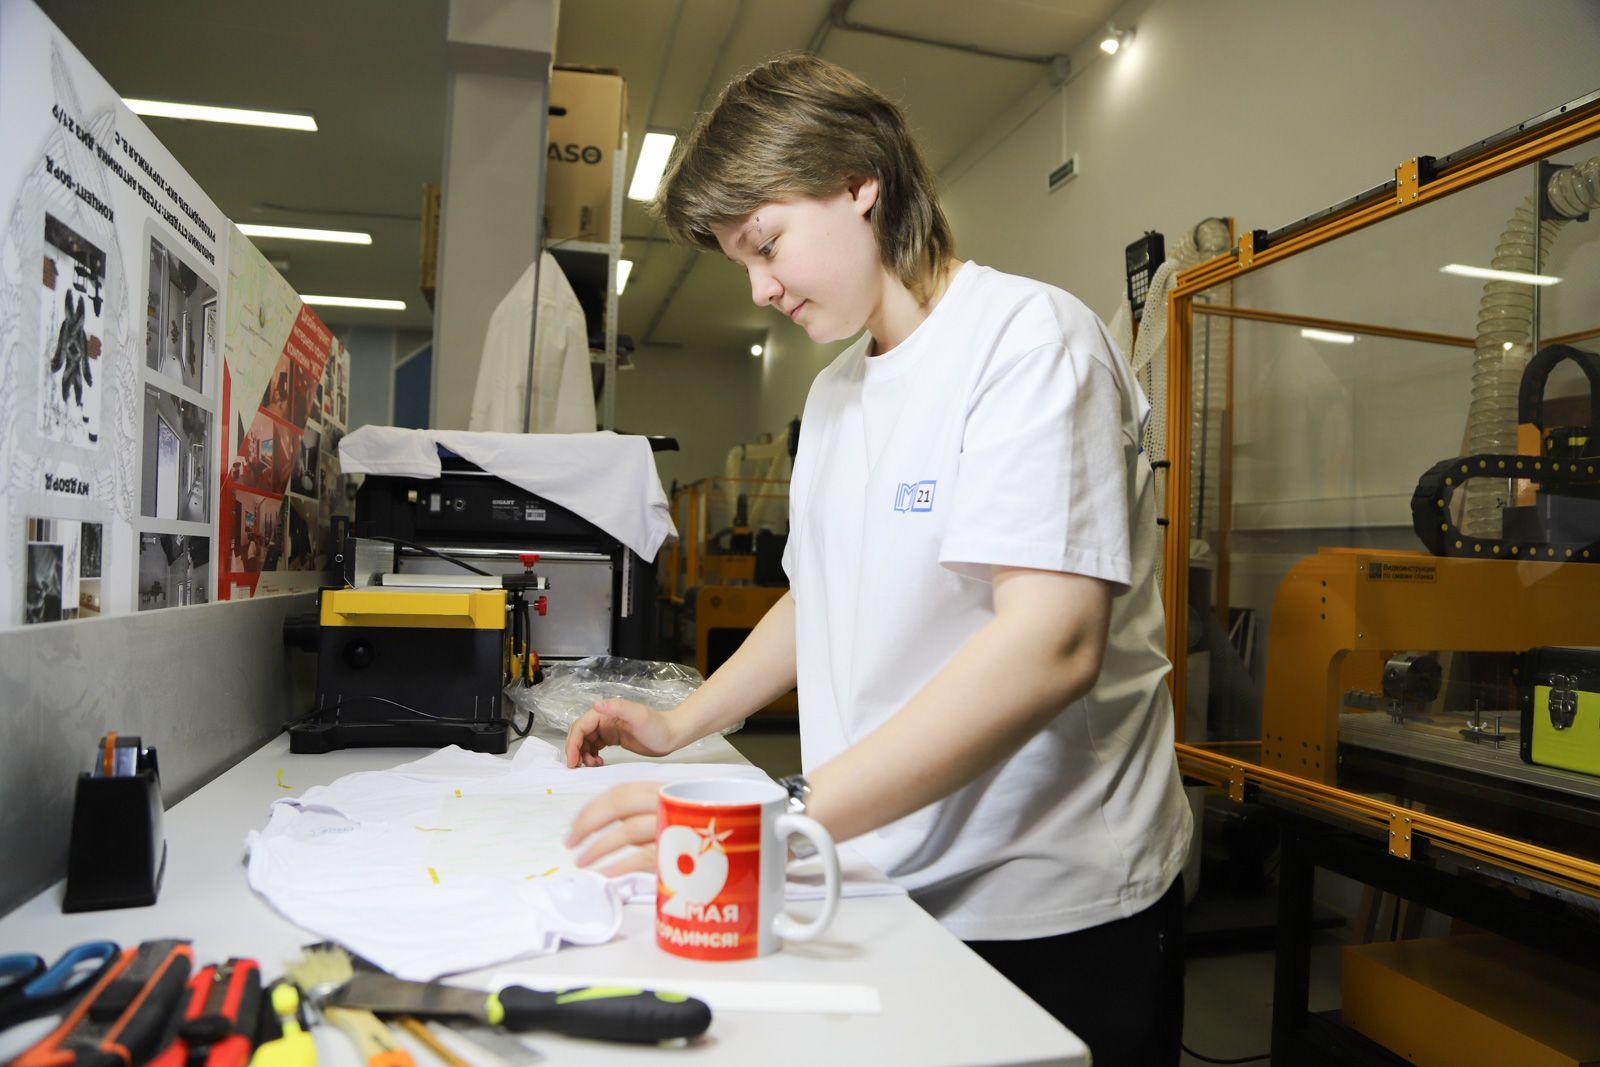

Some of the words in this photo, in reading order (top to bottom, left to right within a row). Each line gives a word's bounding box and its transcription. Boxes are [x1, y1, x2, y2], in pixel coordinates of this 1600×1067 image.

[52, 104, 75, 135] 21/9
[137, 183, 161, 216] ГУСЕВА
[916, 489, 930, 503] 21
[658, 824, 729, 920] 9
[686, 903, 739, 923] МАЯ
